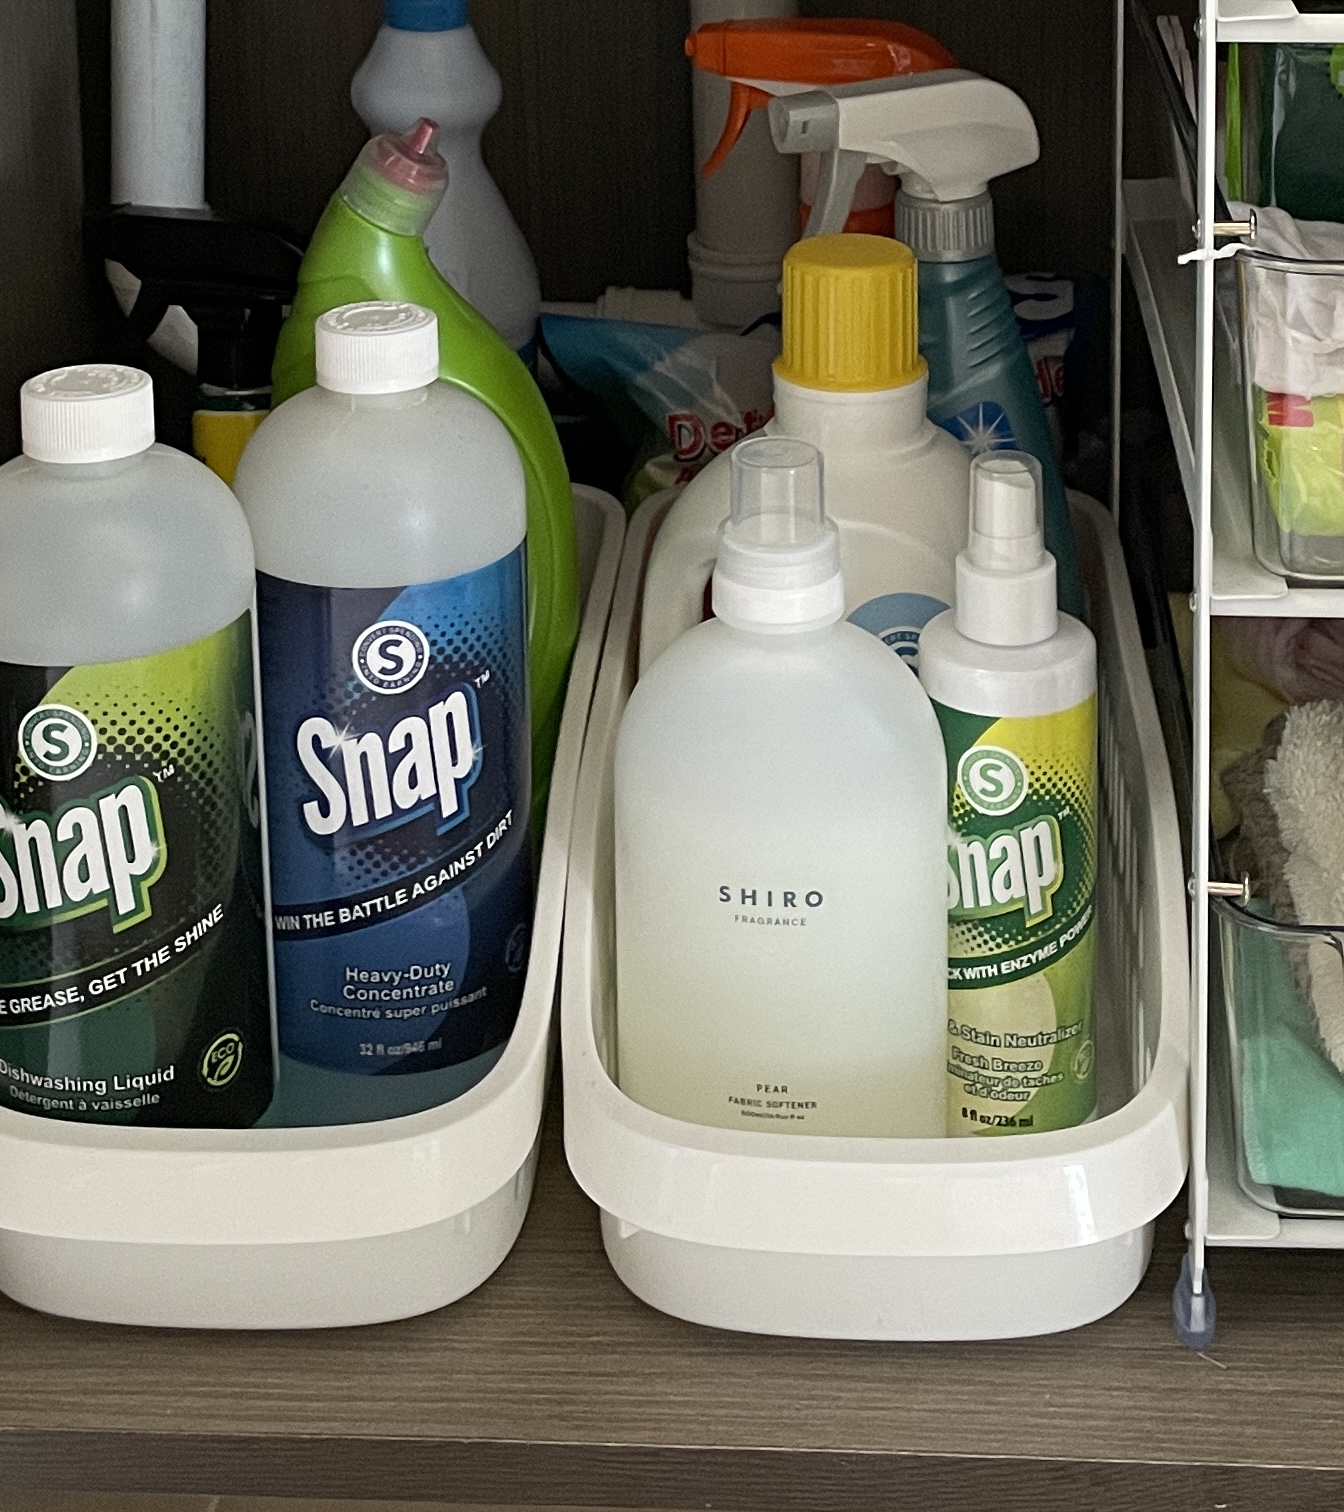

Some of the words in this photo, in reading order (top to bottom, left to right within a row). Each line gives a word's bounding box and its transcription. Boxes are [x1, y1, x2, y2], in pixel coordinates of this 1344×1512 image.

[377, 639, 404, 676] S
[42, 723, 70, 761] S
[297, 691, 474, 835] Snap
[979, 762, 1004, 797] S
[275, 915, 301, 931] WIN
[303, 911, 336, 931] THE
[338, 888, 409, 924] BATTLE
[412, 841, 484, 900] AGAINST
[486, 809, 514, 849] DIRT
[719, 885, 824, 908] SHIRO
[734, 914, 807, 926] FRAGRANCE
[9, 986, 85, 1015] GREASE,
[88, 968, 128, 996] GET
[131, 945, 171, 976] THE
[174, 903, 225, 953] SHINE
[962, 963, 998, 980] WITH
[1000, 941, 1058, 975] ENZYME
[345, 962, 452, 986] Heavy-Duty
[310, 999, 381, 1019] Concentré
[385, 1004, 427, 1020] super
[431, 986, 488, 1015] puissant
[342, 979, 455, 1001] Concentrate
[961, 1024, 1001, 1047] Stain
[1004, 1019, 1084, 1047] Neutralizer
[211, 1042, 235, 1064] ECO
[952, 1046, 989, 1070] Fresh
[992, 1058, 1043, 1072] Breeze
[113, 1065, 175, 1091] Liquid
[756, 1083, 788, 1094] PEAR
[1002, 1076, 1020, 1088] de
[1022, 1072, 1064, 1088] taches
[91, 1093, 161, 1111] vaisselle
[728, 1095, 763, 1108] FABRIC
[766, 1100, 818, 1110] SOFTENER
